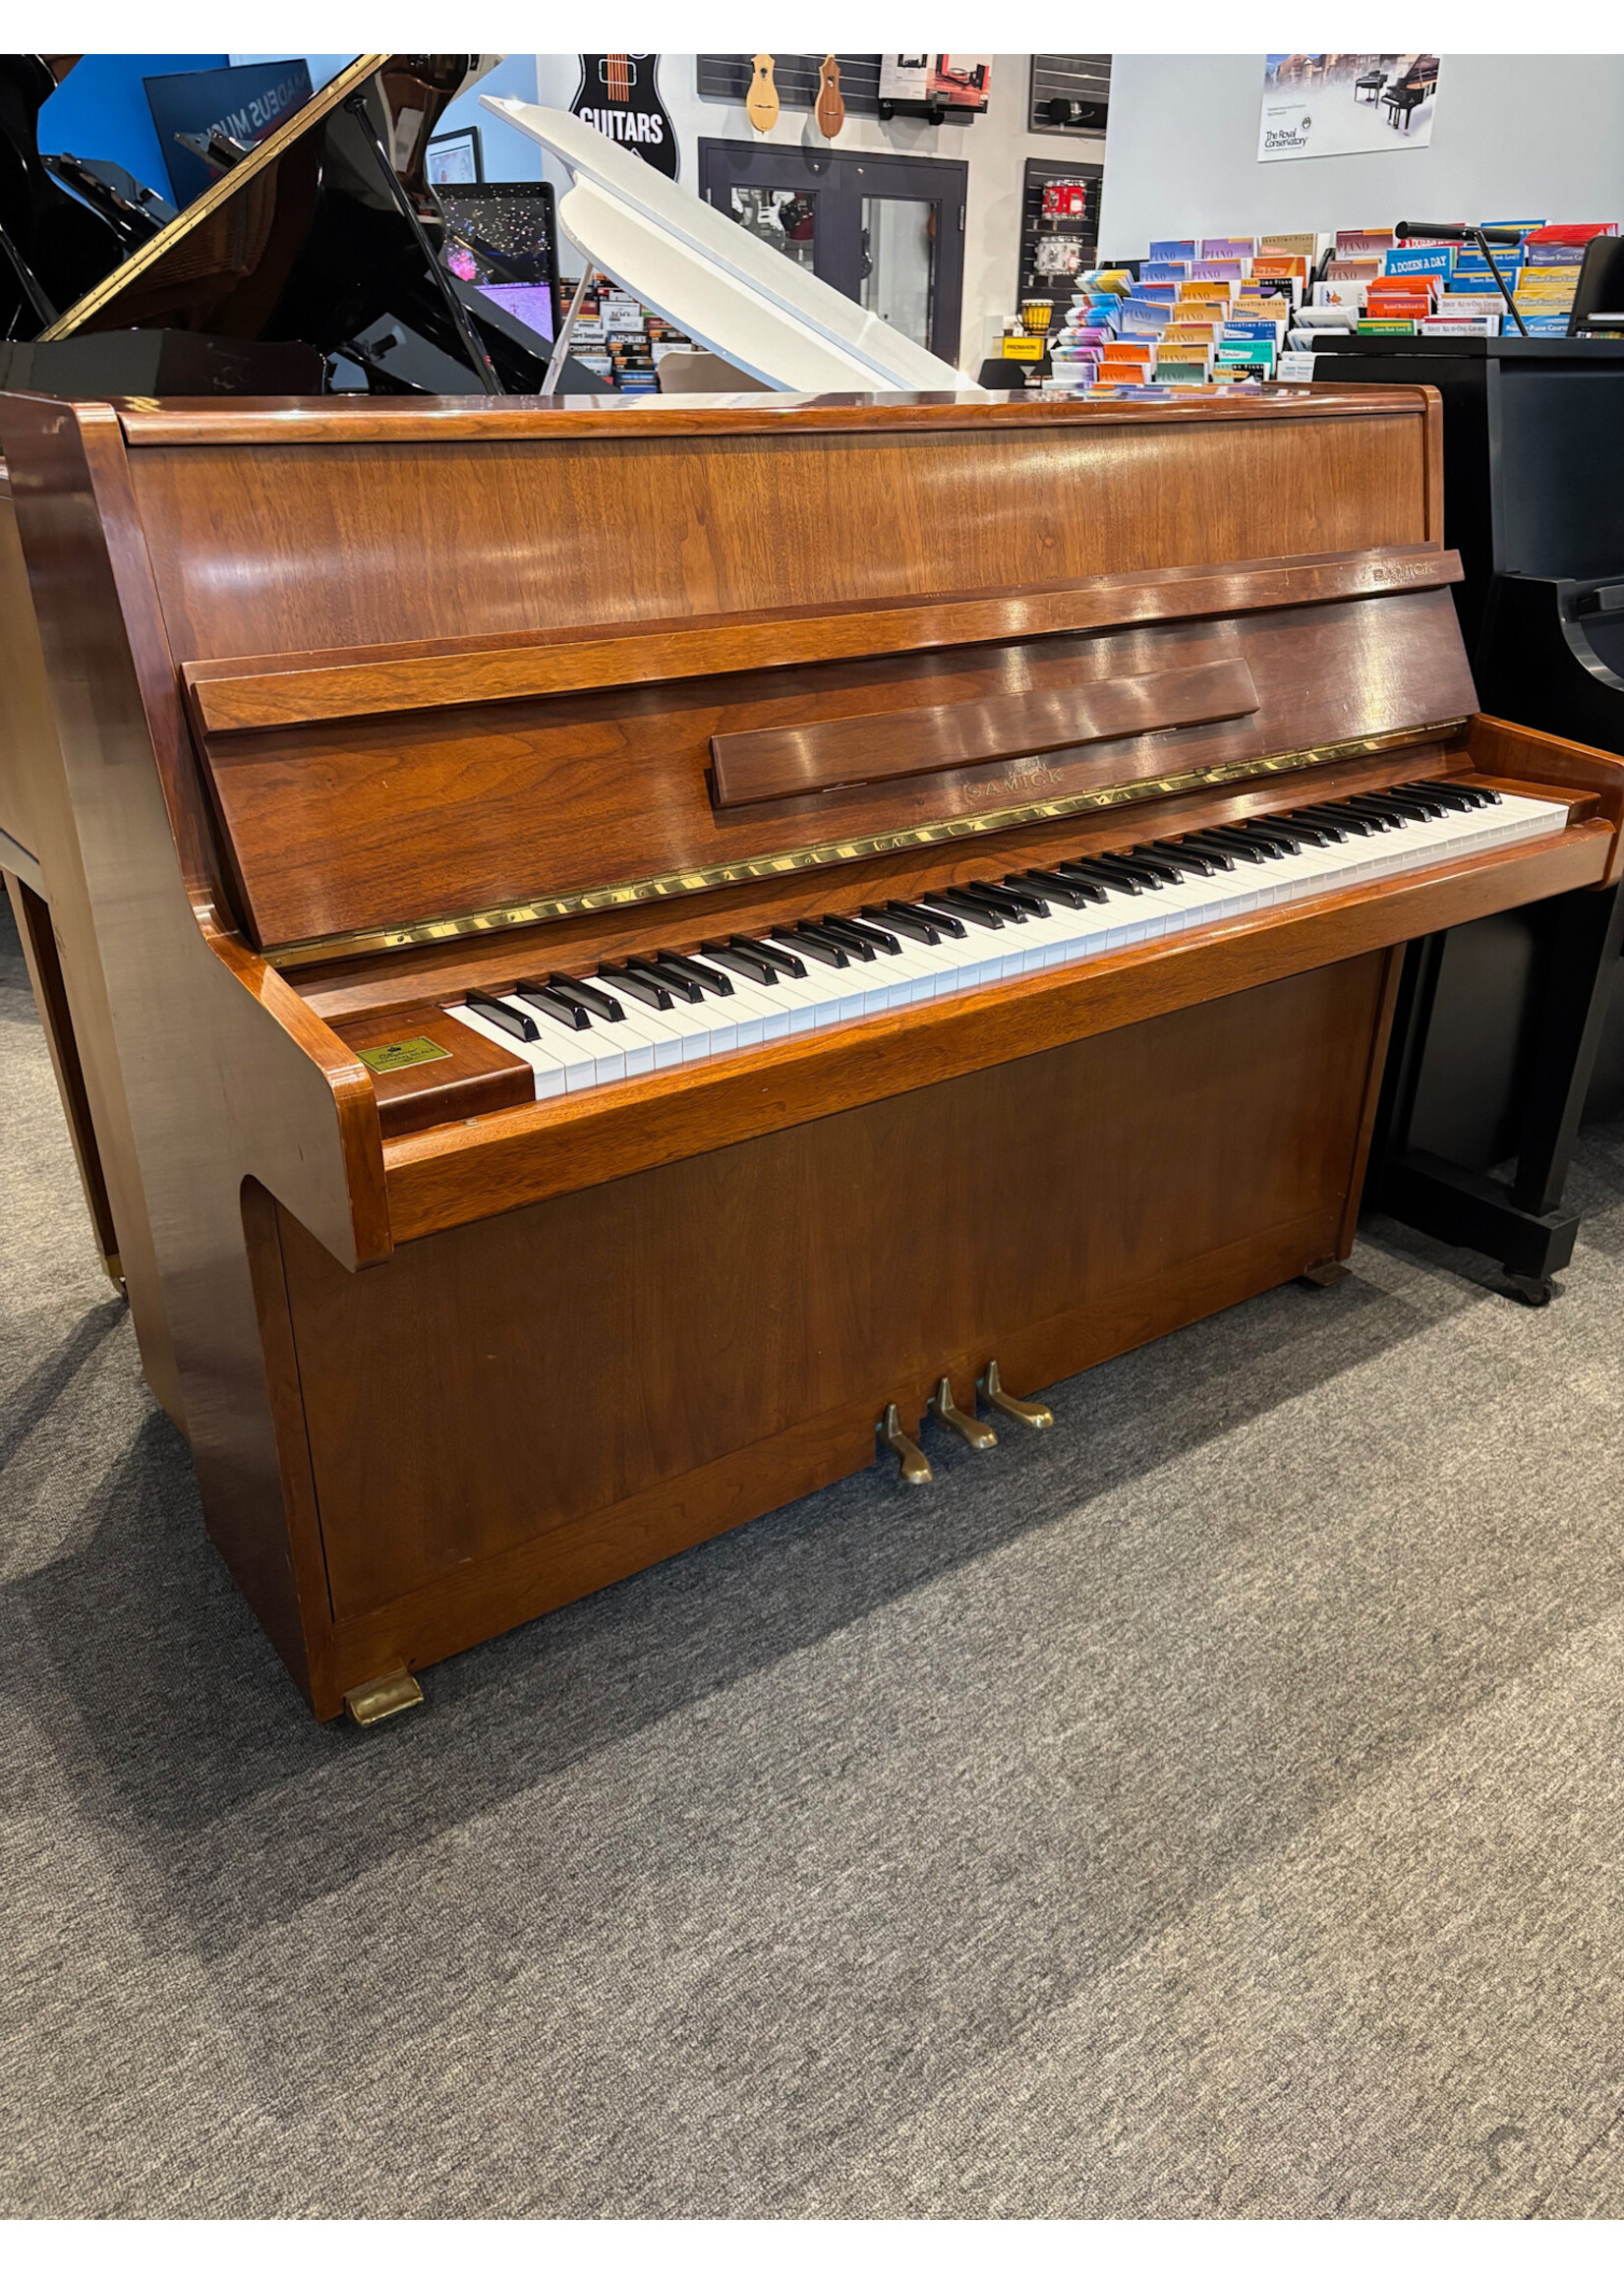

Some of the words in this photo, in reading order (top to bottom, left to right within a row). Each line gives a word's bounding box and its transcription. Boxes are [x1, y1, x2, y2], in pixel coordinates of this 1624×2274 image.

[579, 107, 664, 145] GUITARS
[1266, 131, 1278, 140] The
[1279, 128, 1297, 140] Royal
[1264, 138, 1307, 147] Conservatory
[1337, 241, 1369, 252] PIANO
[1151, 252, 1176, 261] PIANO
[1204, 250, 1233, 260] PIANO
[1390, 263, 1397, 273] A
[1397, 259, 1422, 272] DOZEN
[1423, 259, 1430, 269] A
[1430, 256, 1447, 267] DAY
[1192, 270, 1220, 279] PIANO
[1329, 271, 1358, 280] PIANO
[1125, 309, 1151, 321] PIANO
[1157, 373, 1185, 381] PIANO
[965, 767, 1064, 797] SAMICK
